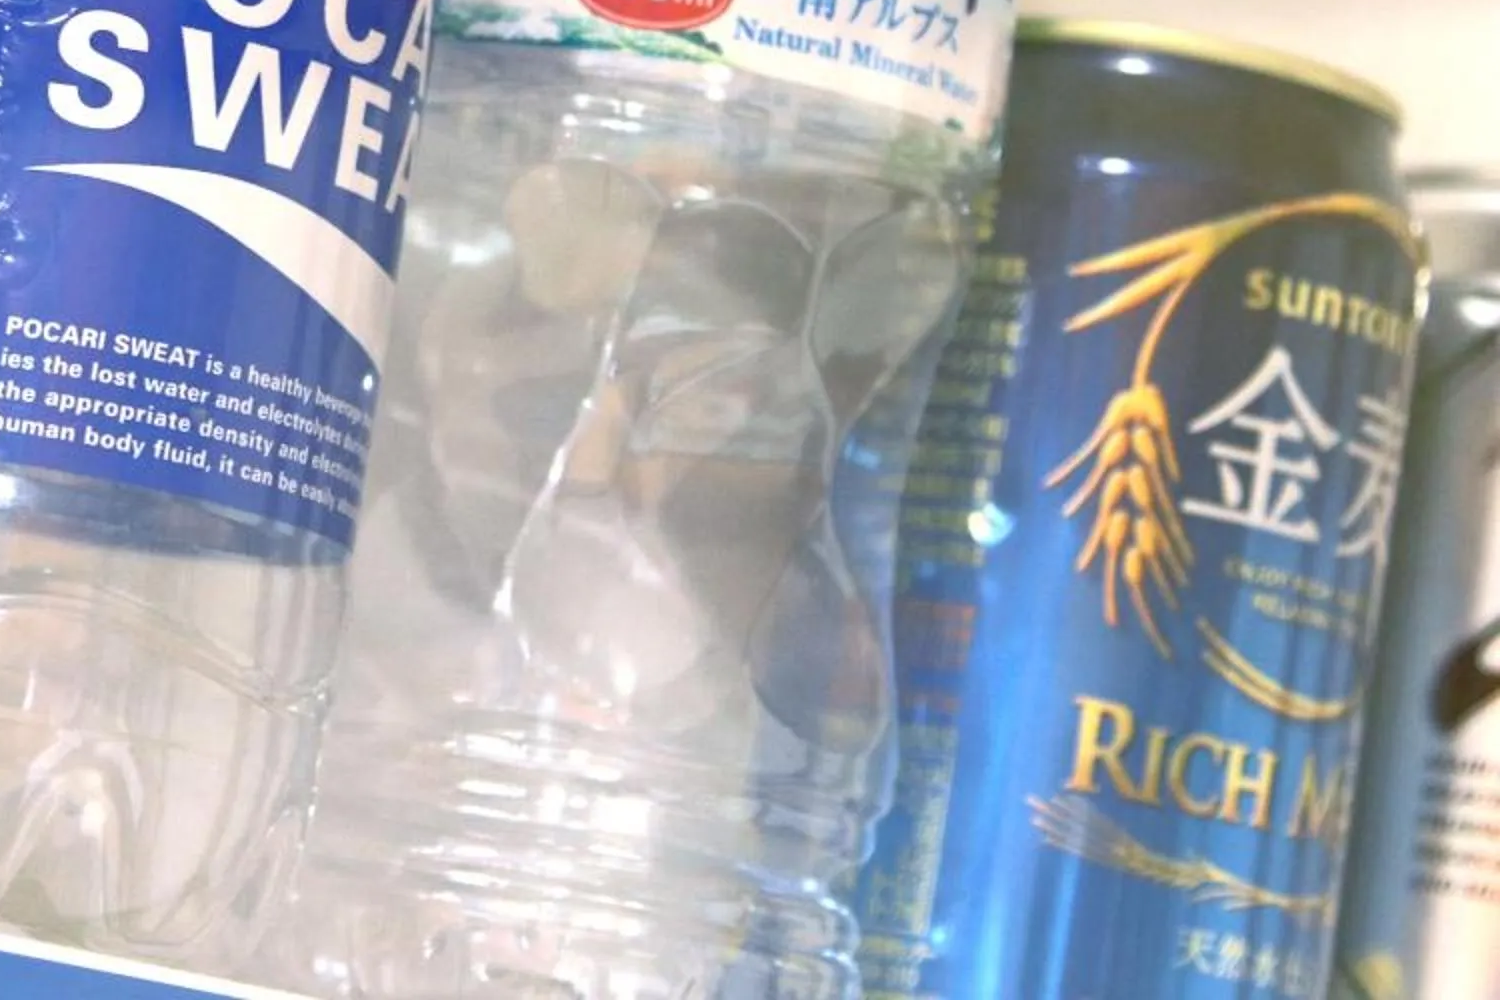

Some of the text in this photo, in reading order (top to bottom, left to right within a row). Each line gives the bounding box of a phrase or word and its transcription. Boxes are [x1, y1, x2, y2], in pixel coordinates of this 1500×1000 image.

[733, 16, 843, 61] Natural
[850, 39, 935, 89] Mineral
[0, 347, 36, 373] ies
[42, 354, 84, 379] the
[90, 364, 136, 390] lost
[143, 376, 210, 405] water
[215, 390, 255, 416] and
[5, 315, 106, 350] POCARI
[113, 334, 202, 369] SWEAT
[205, 353, 225, 376] is
[229, 364, 244, 382] a
[247, 364, 314, 405] healthy
[43, 387, 192, 434] appropriate
[198, 418, 275, 458] density
[277, 441, 309, 475] and
[83, 425, 146, 460] body
[153, 440, 212, 473] fluid,
[218, 453, 235, 477] it
[239, 463, 274, 487] can
[277, 470, 299, 494] be
[1065, 693, 1278, 831] RICH
